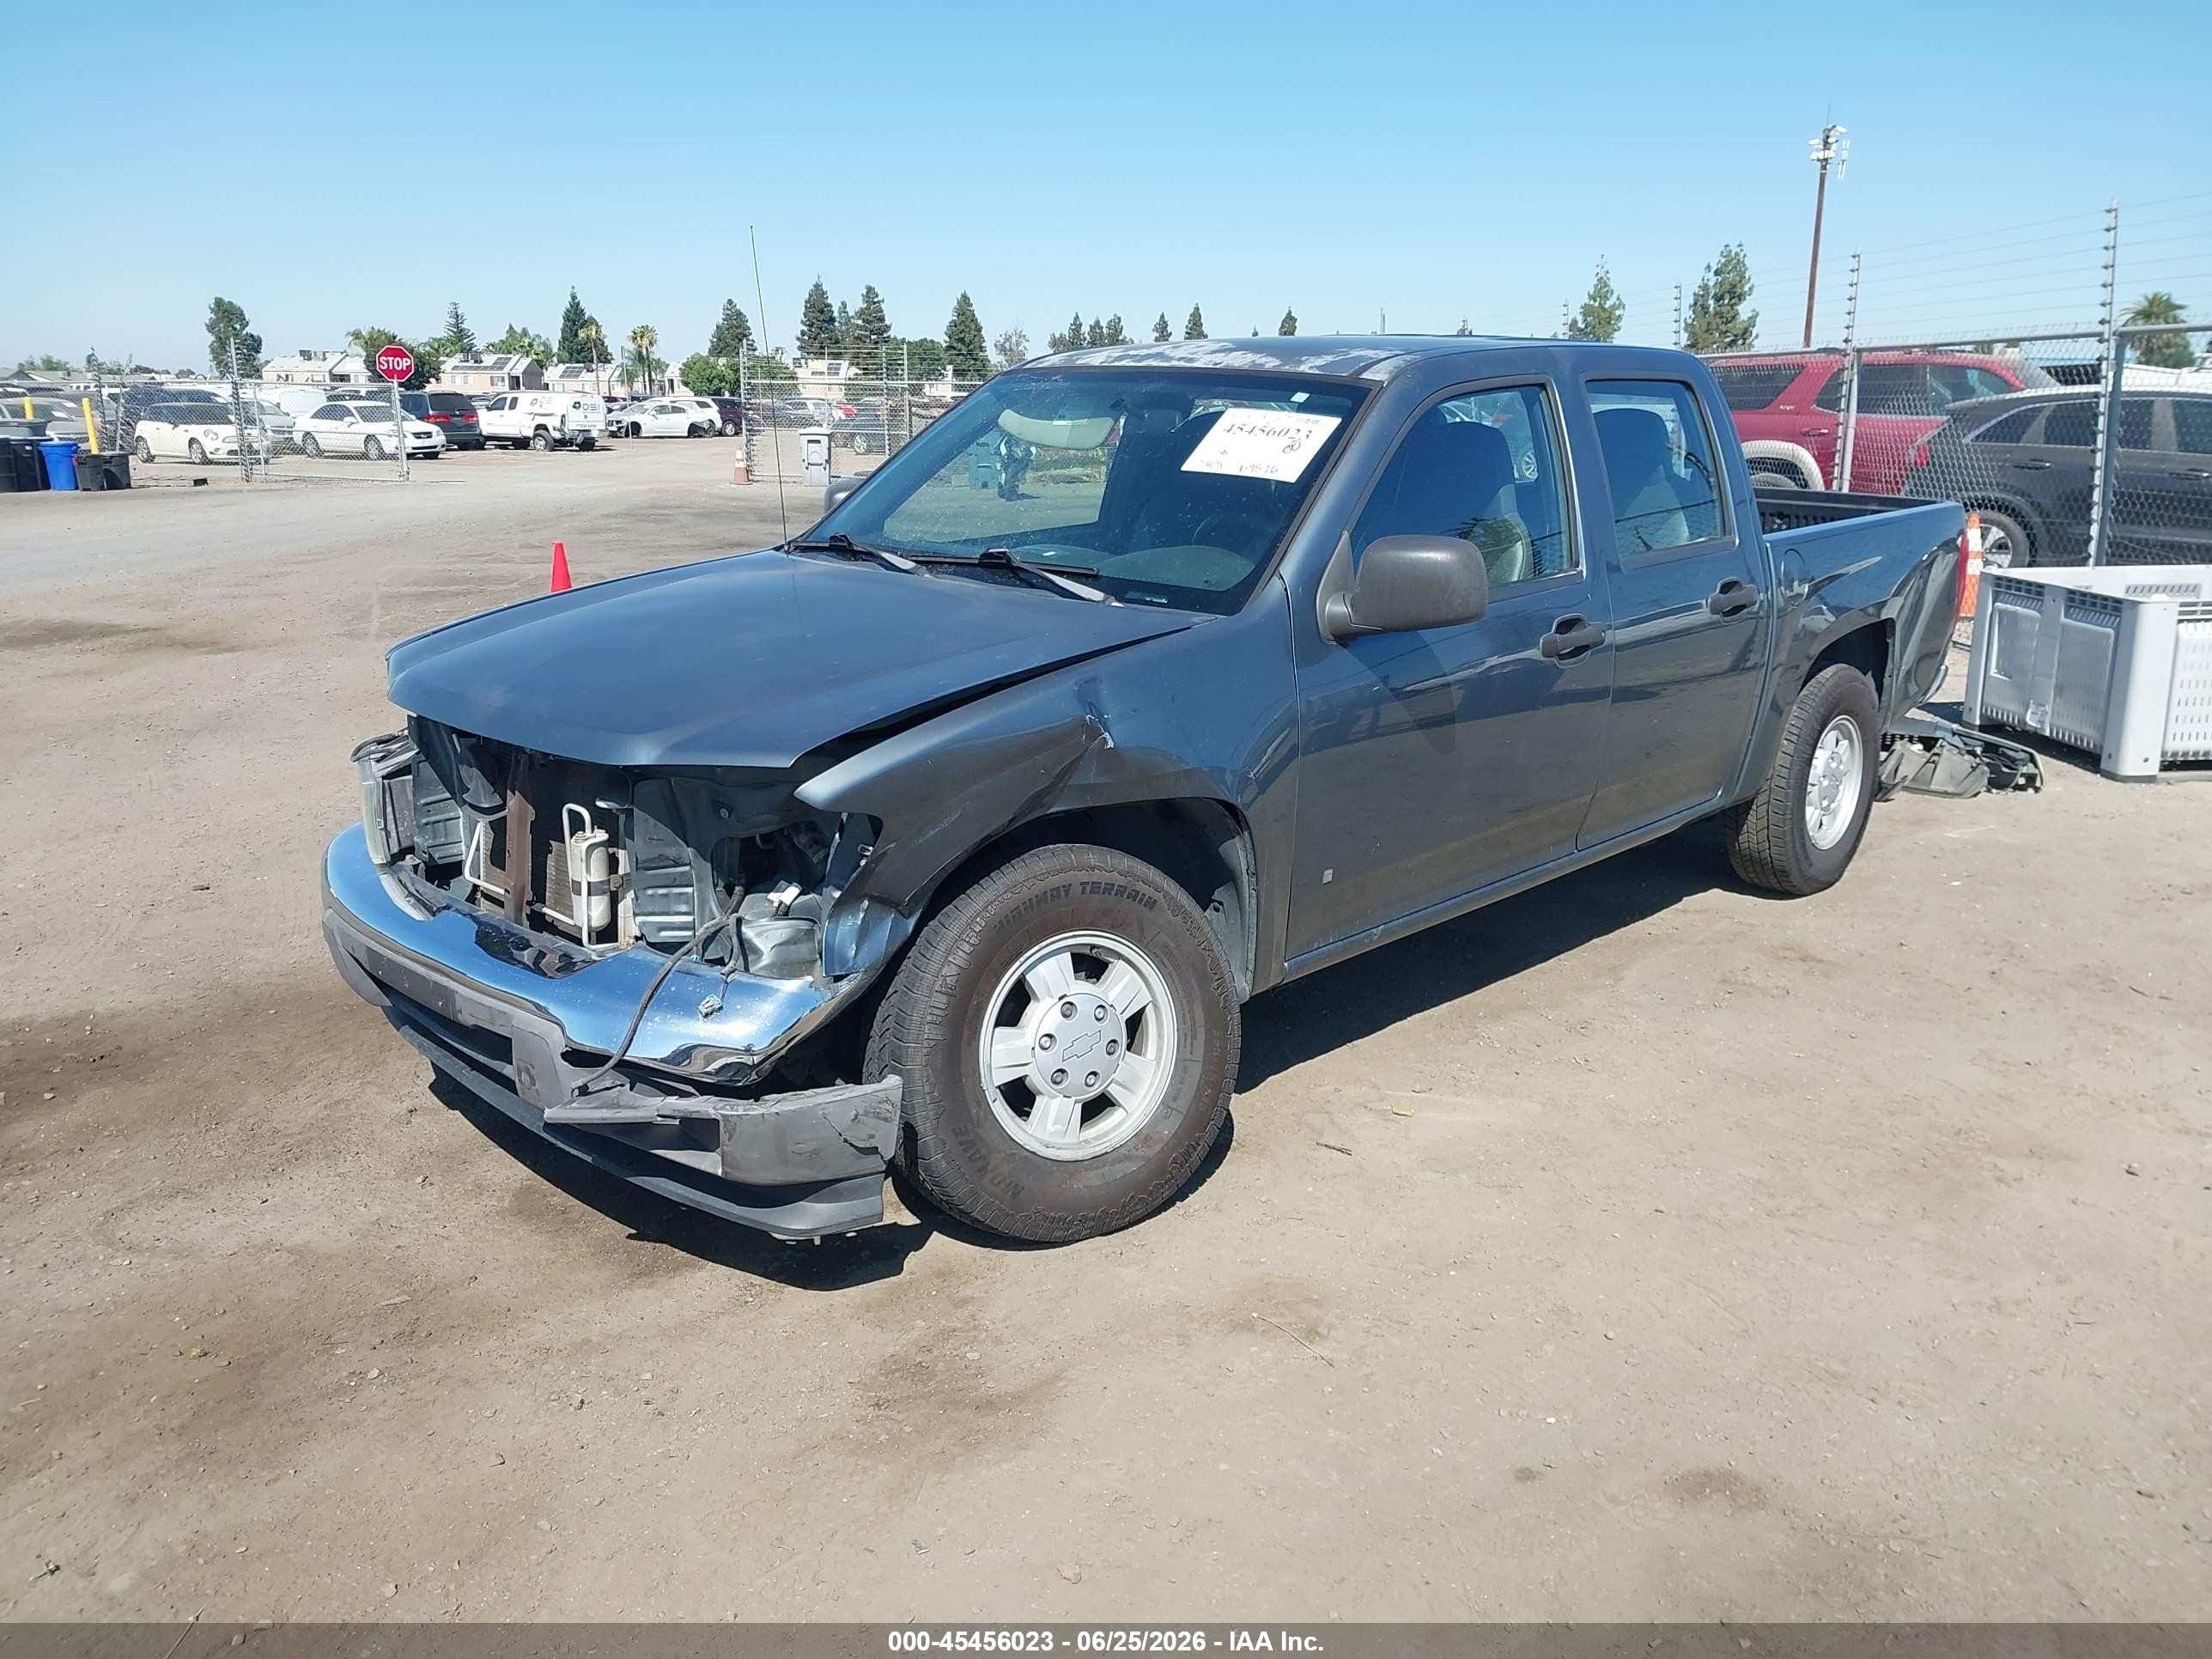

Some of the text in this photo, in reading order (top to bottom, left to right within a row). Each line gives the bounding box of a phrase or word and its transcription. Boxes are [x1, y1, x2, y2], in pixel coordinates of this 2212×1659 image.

[379, 356, 411, 371] STOP
[582, 403, 600, 411] OSI
[1223, 422, 1313, 441] 45456023
[1079, 881, 1158, 910] TERRAIN
